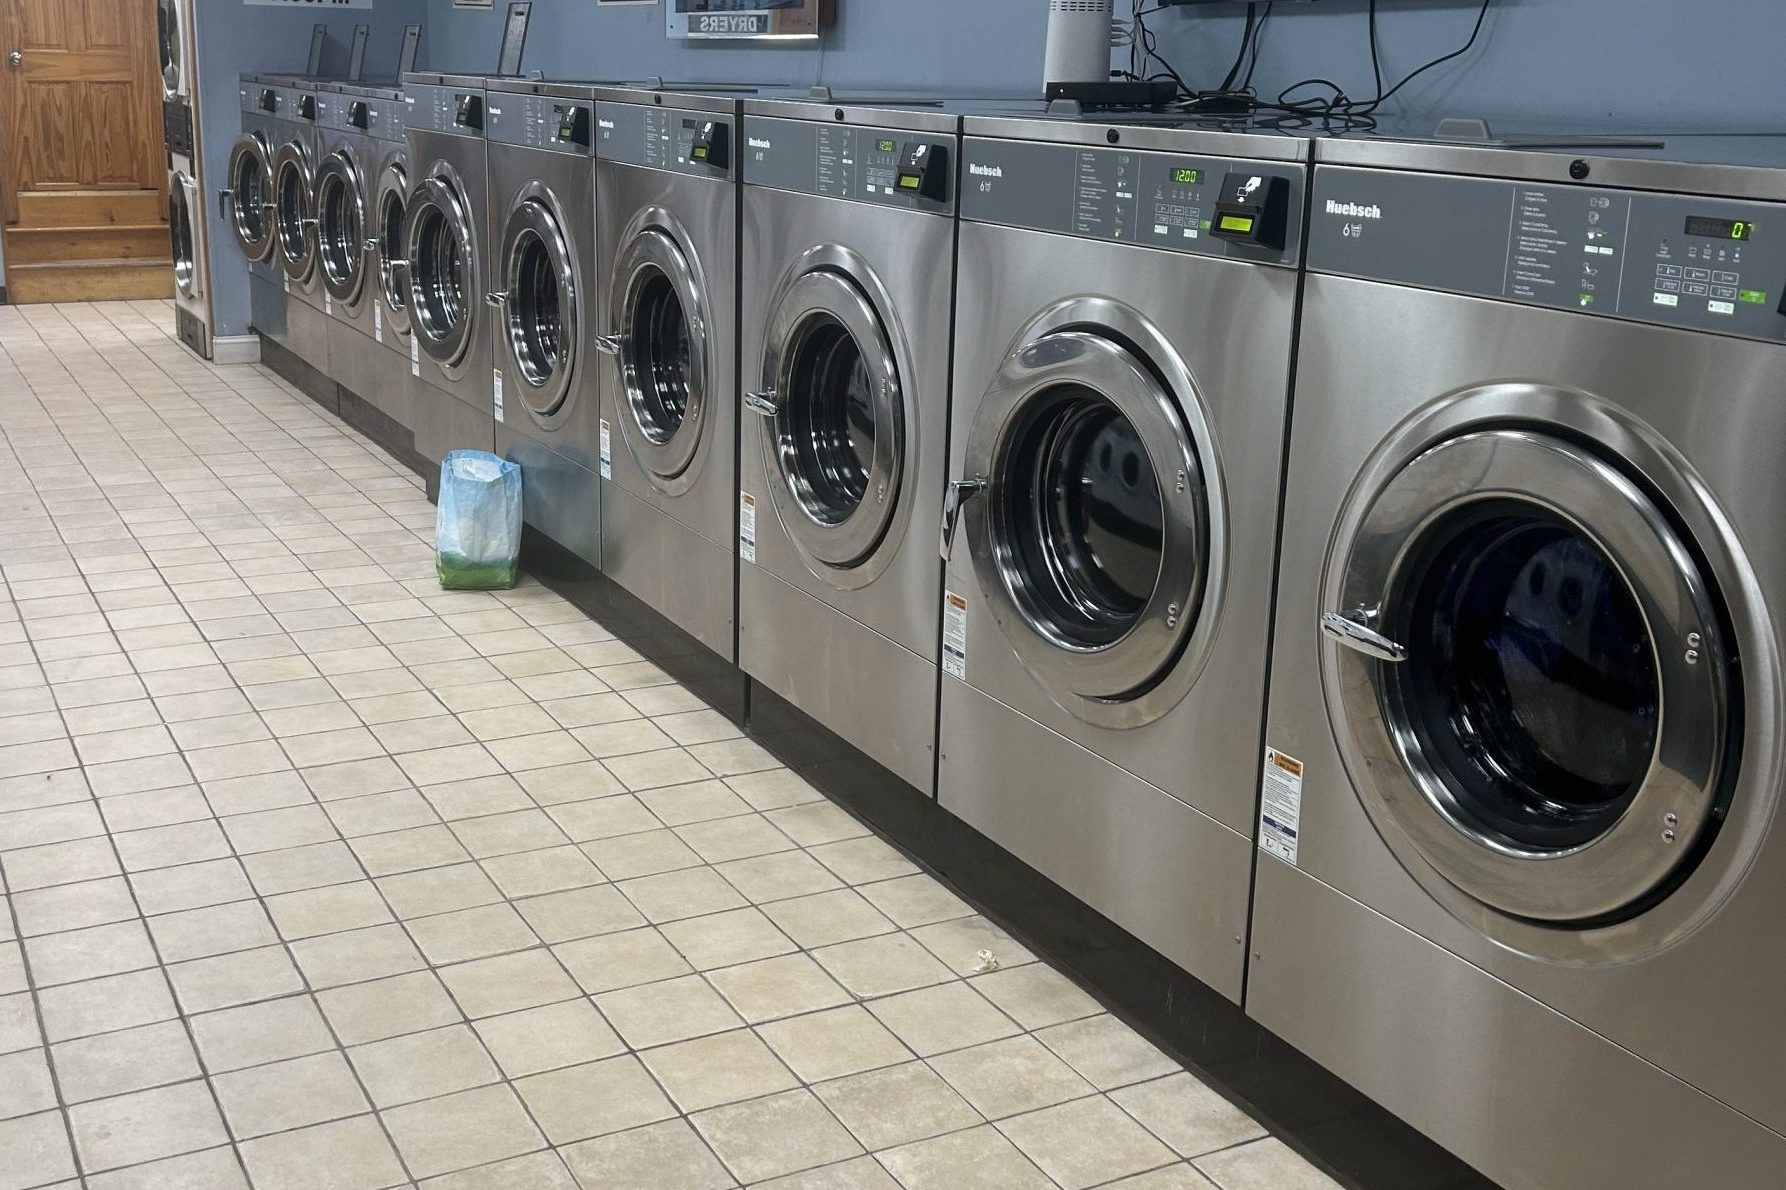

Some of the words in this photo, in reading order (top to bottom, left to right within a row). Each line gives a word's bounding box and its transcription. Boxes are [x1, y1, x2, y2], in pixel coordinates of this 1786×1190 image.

[969, 162, 1002, 177] Huebsch
[1325, 199, 1381, 219] Huebsch
[1342, 222, 1350, 236] 6
